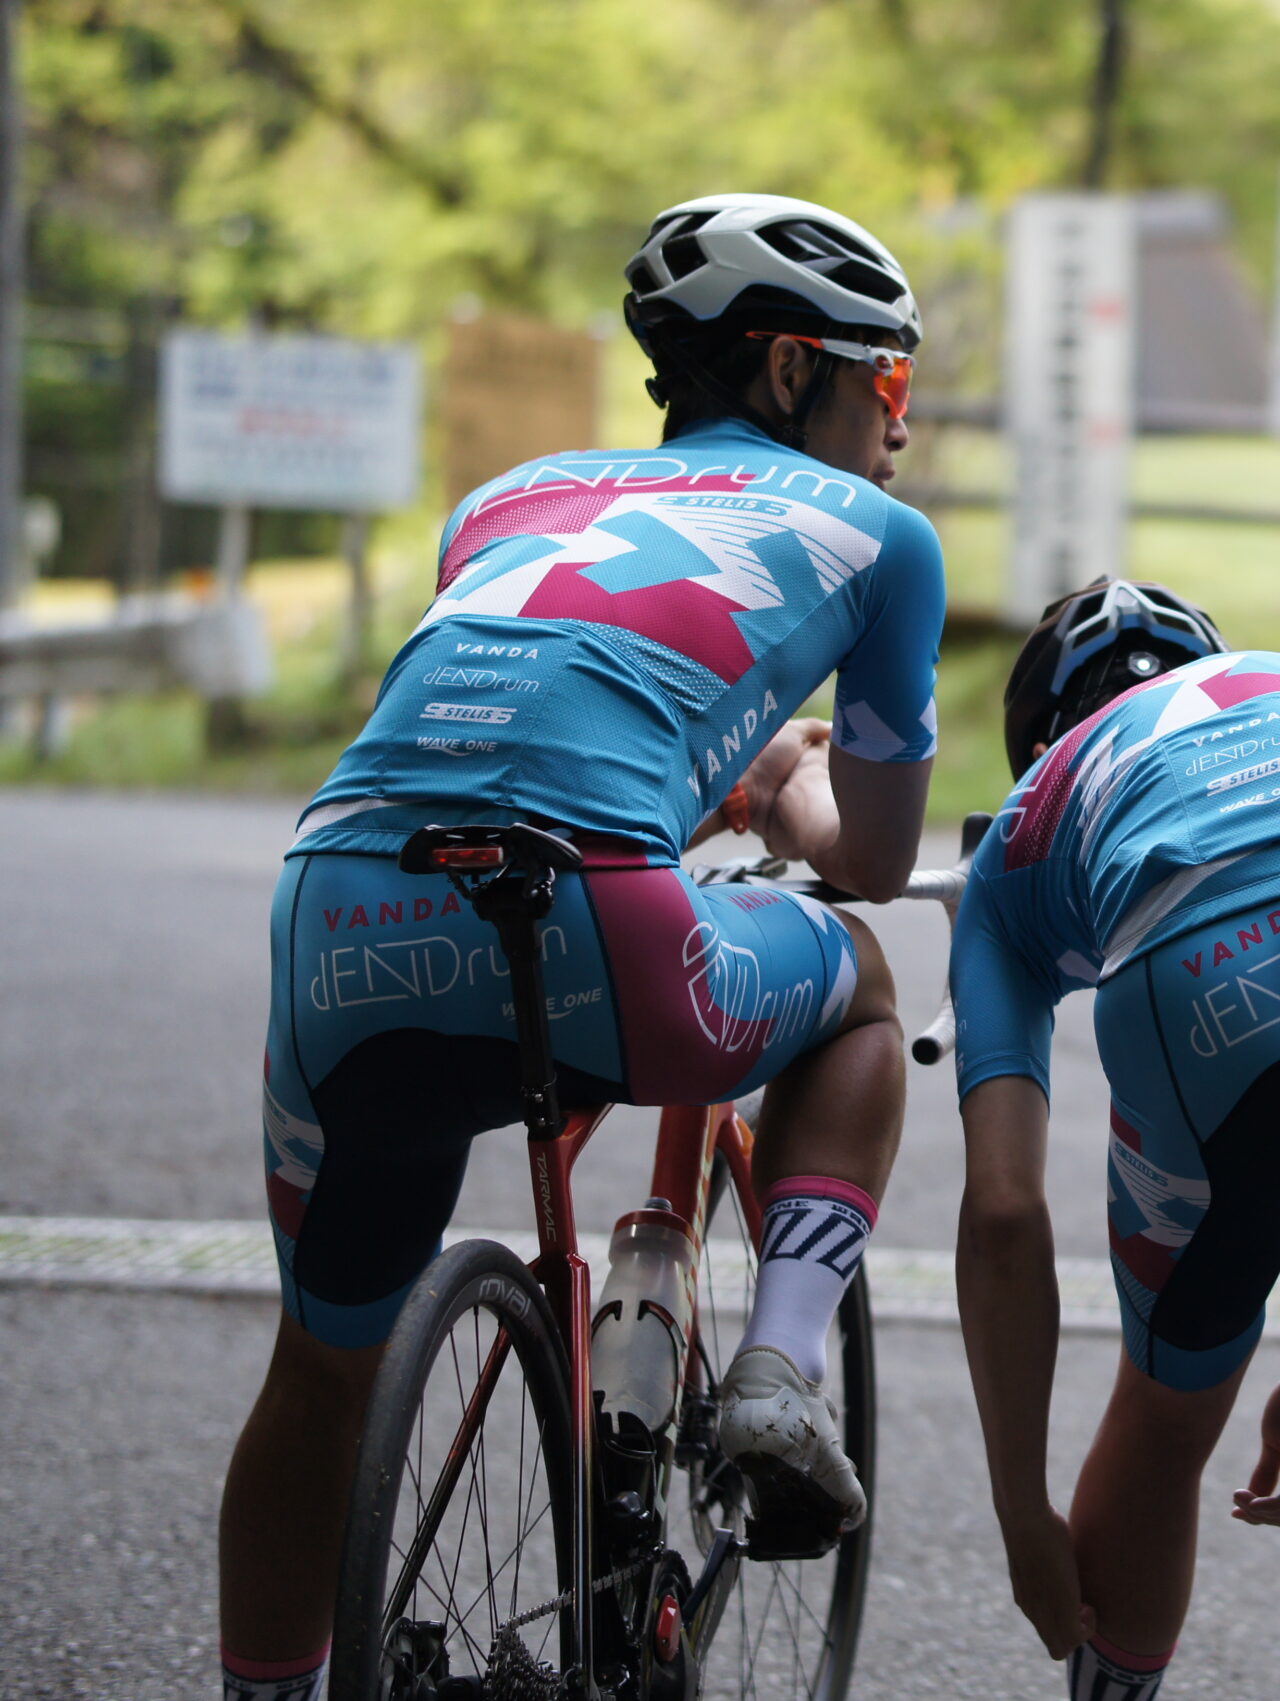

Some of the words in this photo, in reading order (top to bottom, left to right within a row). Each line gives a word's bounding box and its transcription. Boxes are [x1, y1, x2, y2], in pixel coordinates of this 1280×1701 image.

[456, 643, 538, 660] VANDA
[416, 737, 461, 749] WAVE
[465, 741, 498, 753] ONE
[687, 689, 778, 798] VANDA
[1192, 712, 1280, 748] VANDA
[1220, 793, 1265, 813] WAVE
[323, 892, 461, 932] VANDA
[502, 997, 555, 1018] WE
[563, 988, 602, 1008] ONE
[537, 1152, 557, 1242] TARMAC
